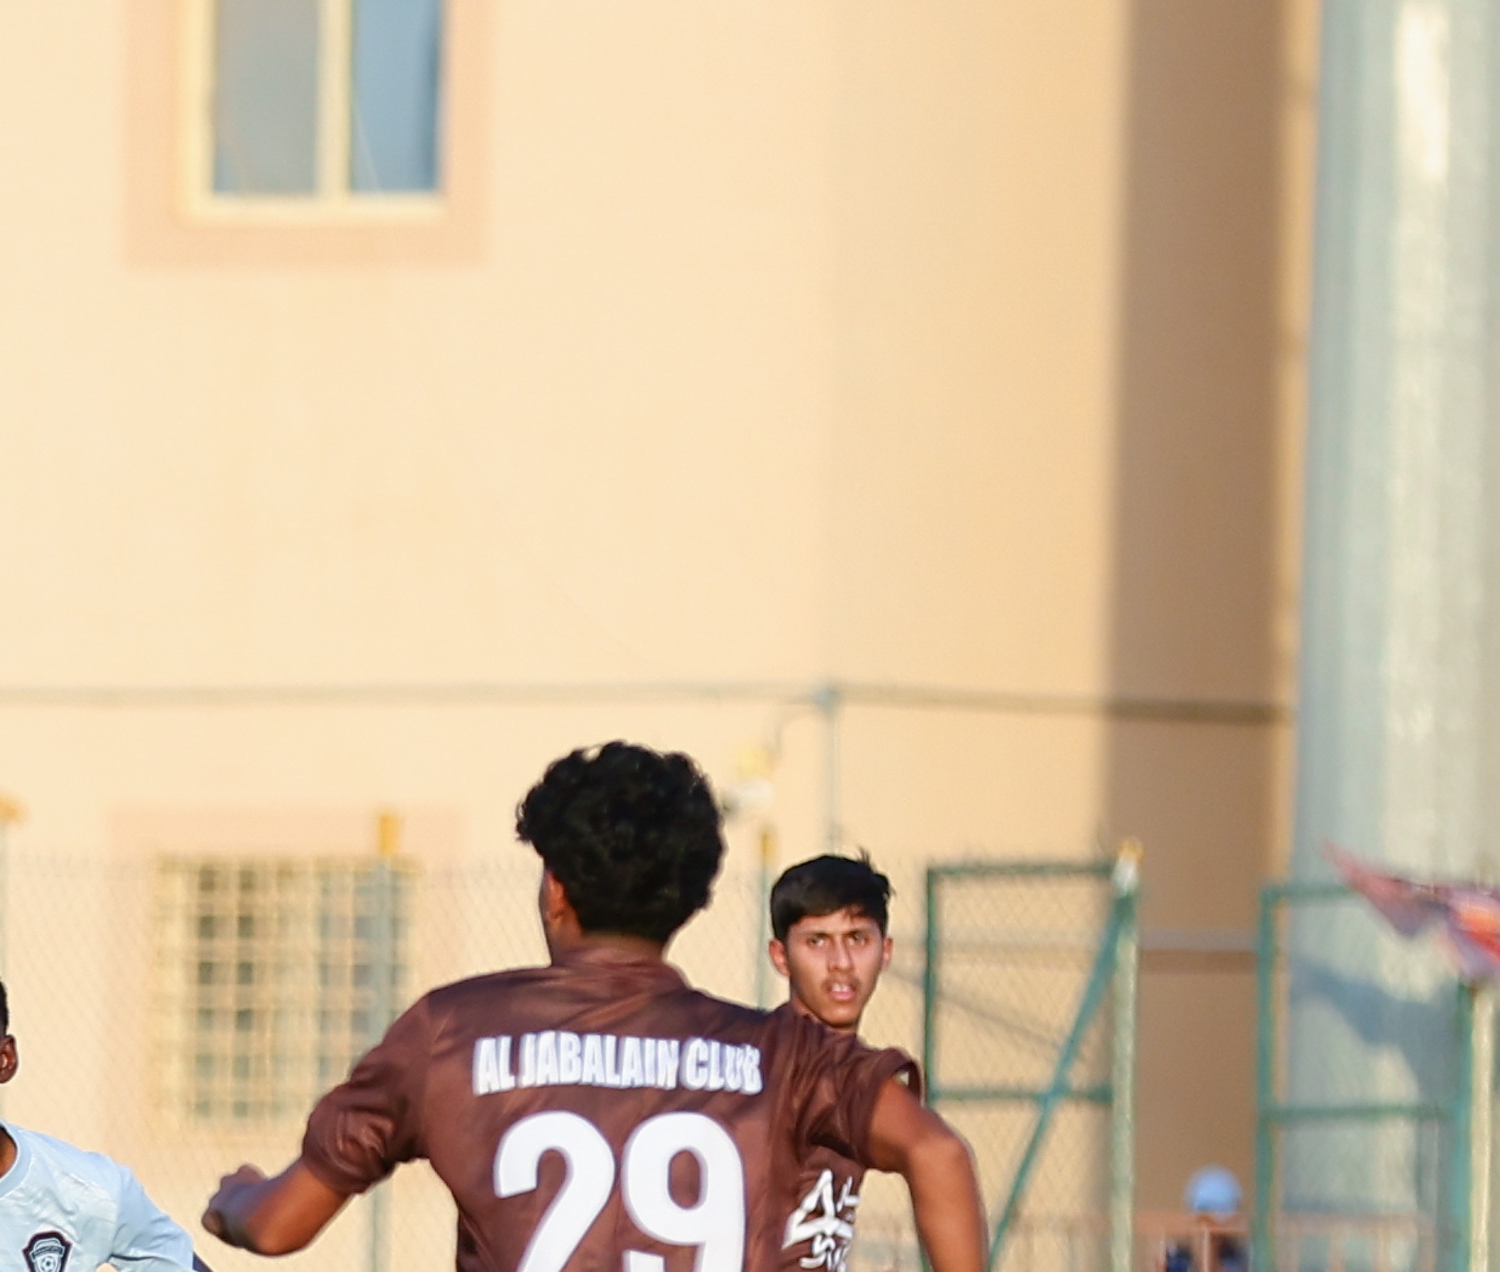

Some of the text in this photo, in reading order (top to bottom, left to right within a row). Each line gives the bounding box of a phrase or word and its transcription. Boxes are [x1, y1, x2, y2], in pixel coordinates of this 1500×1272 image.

[473, 1030, 763, 1096] AL JABALAIN CLUB
